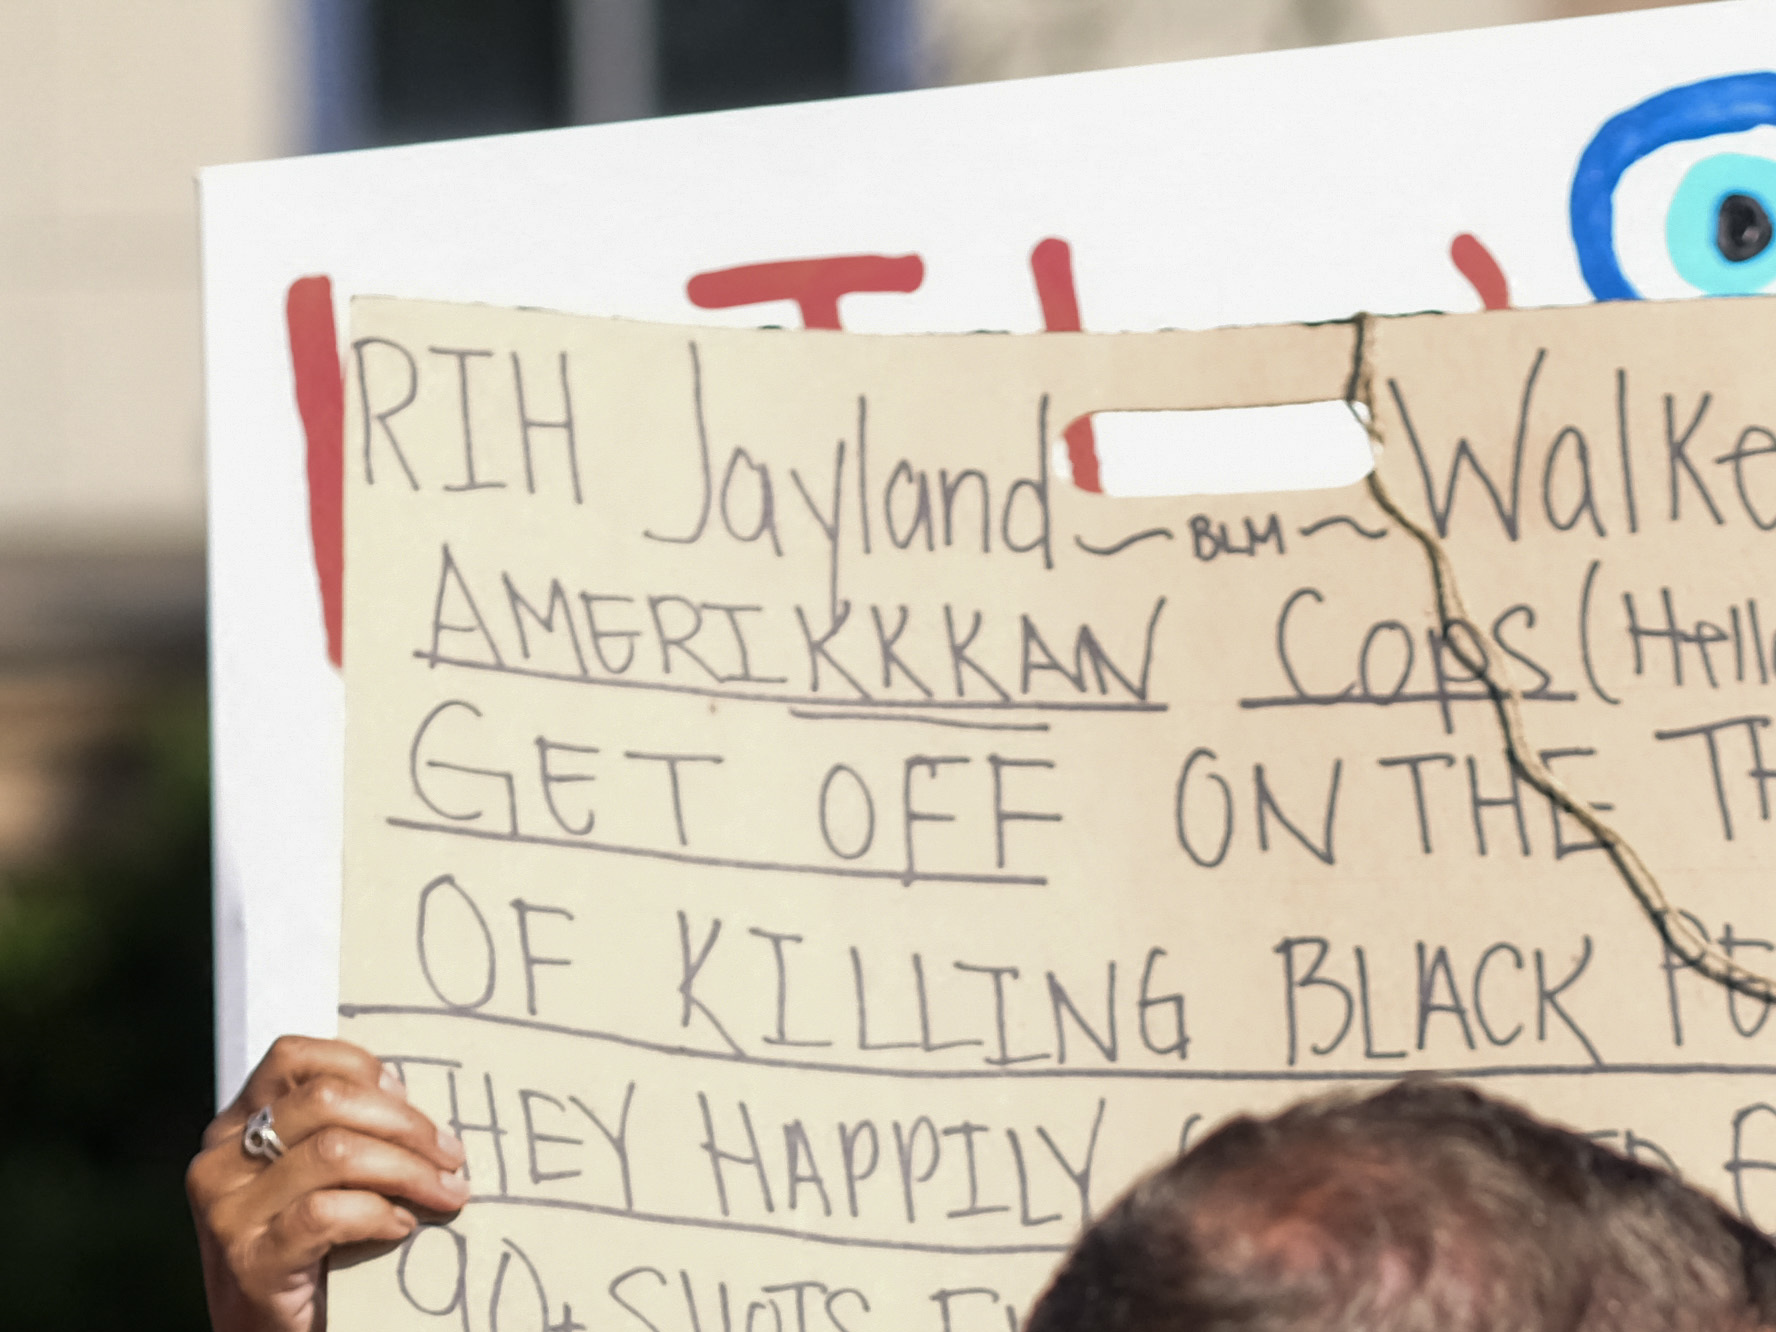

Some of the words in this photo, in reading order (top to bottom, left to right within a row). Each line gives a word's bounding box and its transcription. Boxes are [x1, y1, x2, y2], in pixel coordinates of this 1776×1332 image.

[351, 336, 583, 506] RIH
[644, 339, 1054, 627] Jayland
[429, 544, 1168, 702] AMERIKKKAN
[410, 699, 726, 846] GET
[818, 753, 1066, 886] OFF
[1174, 747, 1344, 866] ON
[1377, 744, 1617, 861] THE
[416, 873, 576, 1016] OF
[675, 907, 1191, 1067] KILLING
[1273, 934, 1606, 1070] BLACK
[698, 1092, 1107, 1229] HAPPILY
